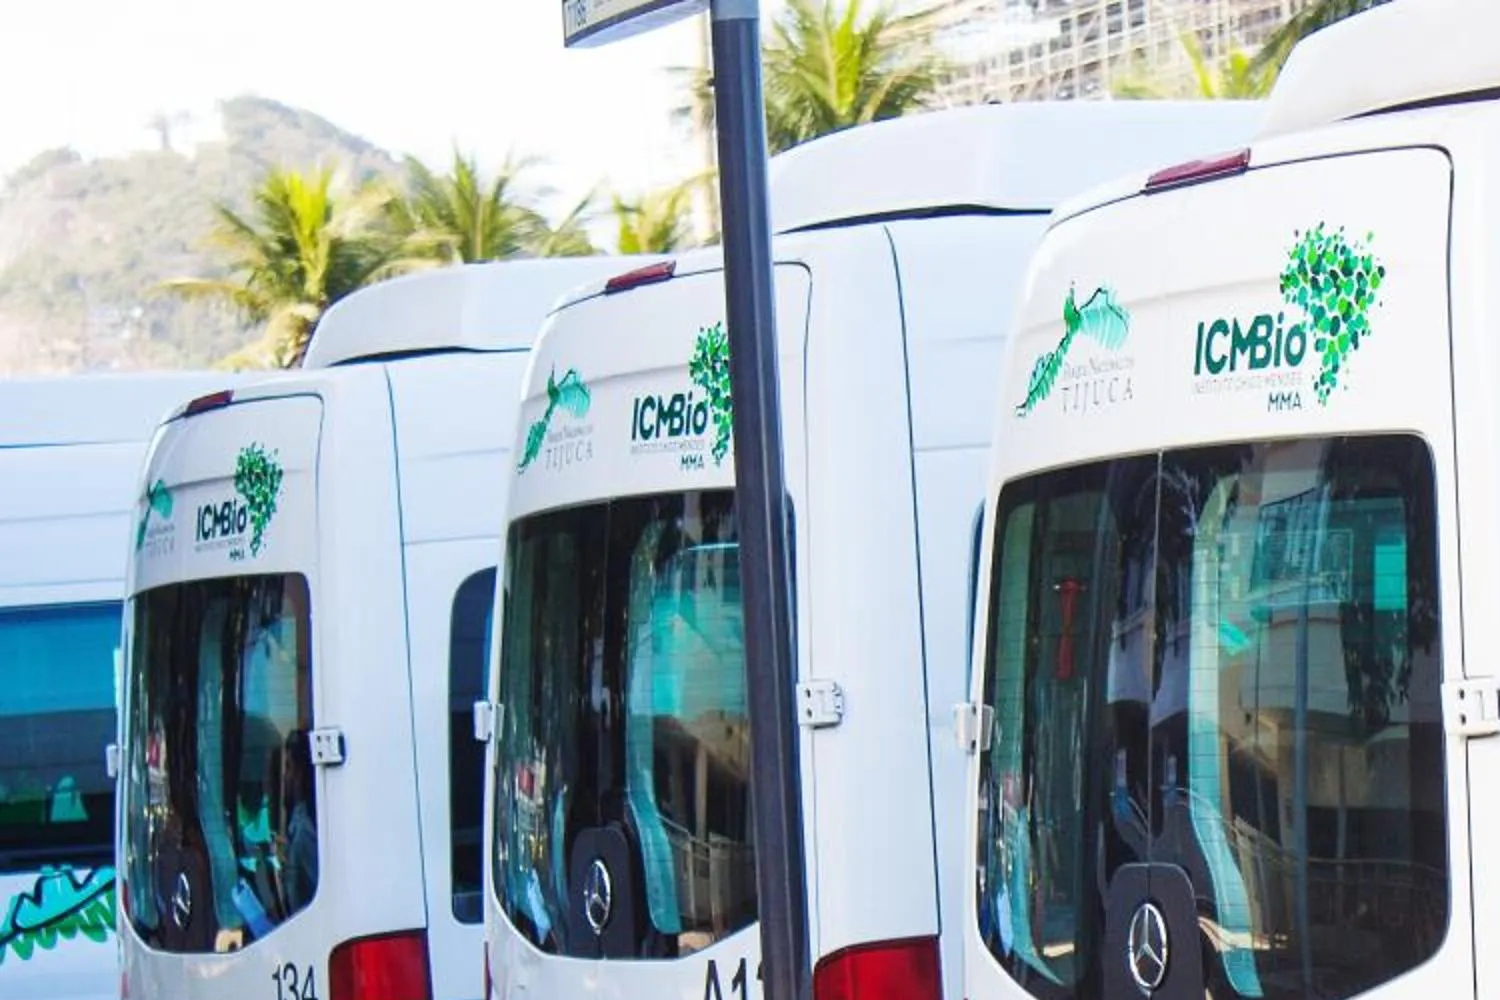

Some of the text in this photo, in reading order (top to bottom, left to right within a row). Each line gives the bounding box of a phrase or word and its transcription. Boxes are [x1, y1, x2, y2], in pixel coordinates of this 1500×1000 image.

[1194, 311, 1307, 376] ICMBio
[632, 390, 708, 441] ICMBio
[1267, 391, 1302, 413] MMA
[195, 498, 247, 542] ICMBio
